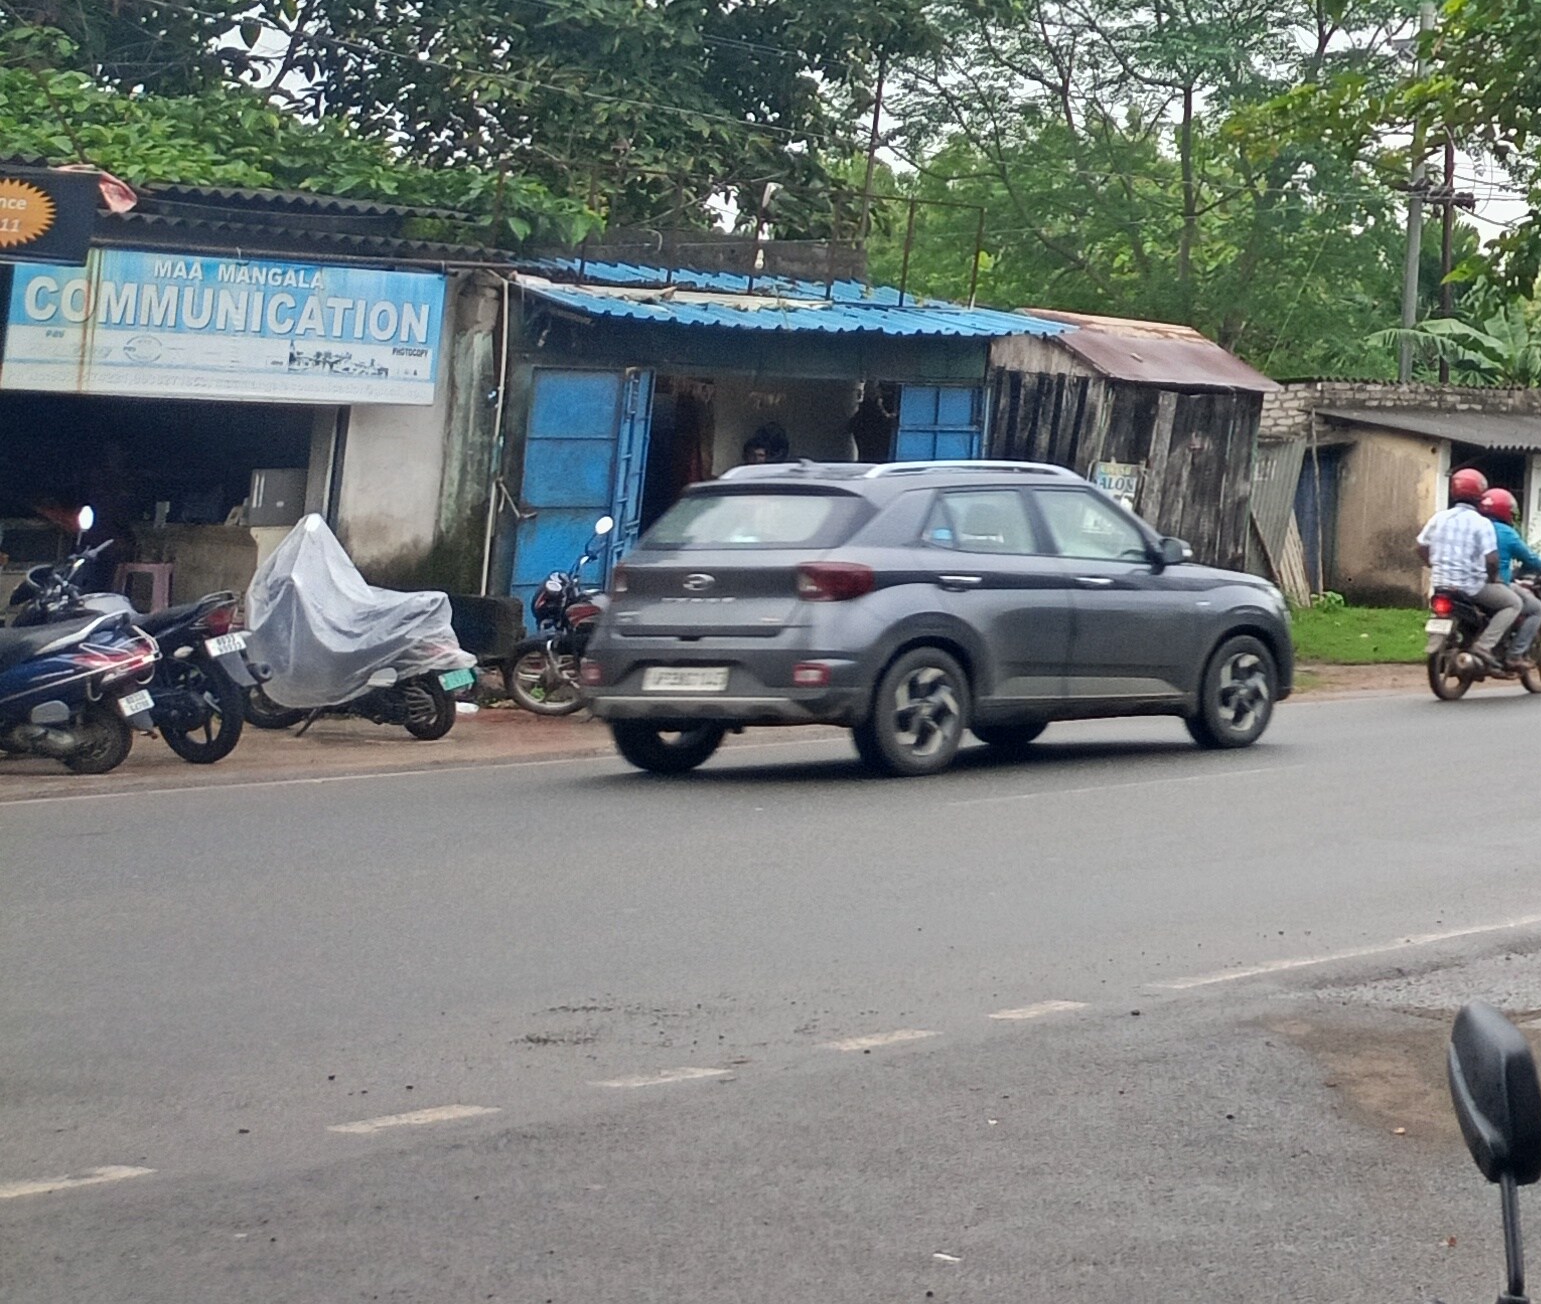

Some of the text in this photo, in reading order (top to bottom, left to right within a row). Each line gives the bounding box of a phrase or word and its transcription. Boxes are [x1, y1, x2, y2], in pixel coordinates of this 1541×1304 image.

[154, 259, 325, 291] MAA MANGALA
[24, 275, 430, 344] COMMUNICATION
[392, 347, 430, 358] PHOTOCOPY
[1098, 477, 1136, 492] ALON
